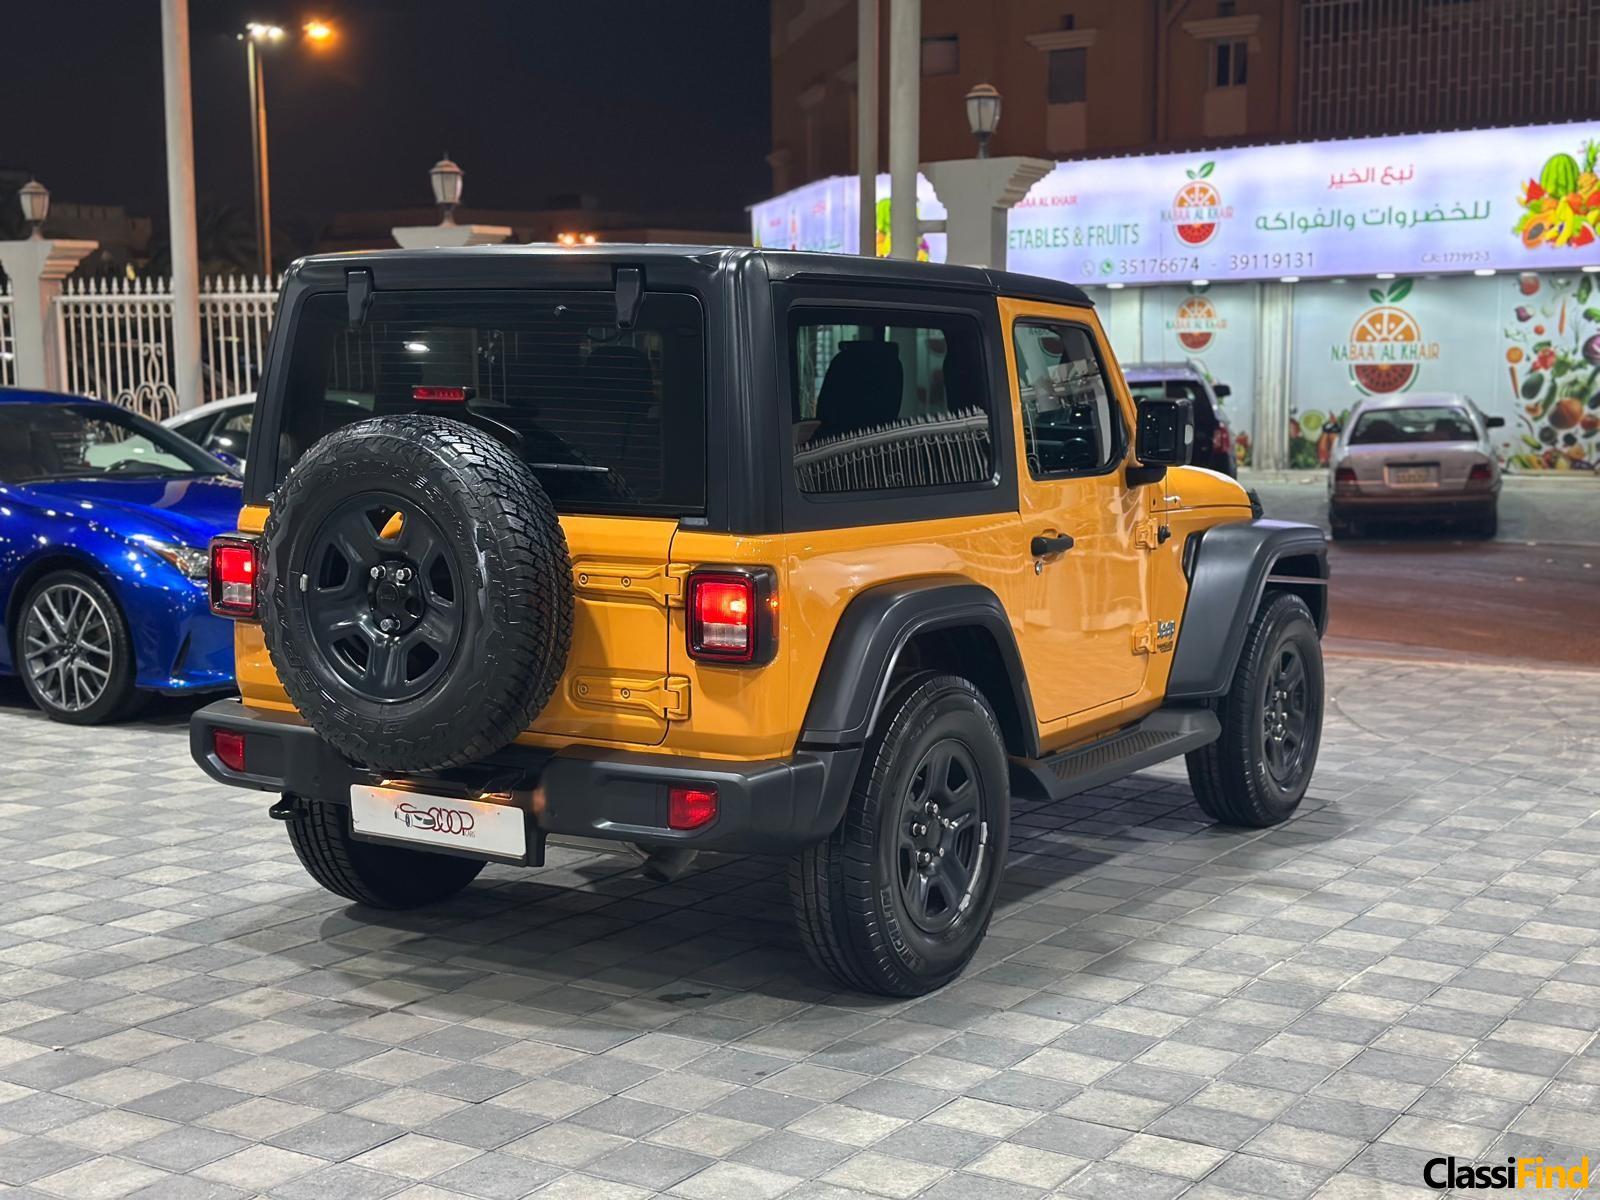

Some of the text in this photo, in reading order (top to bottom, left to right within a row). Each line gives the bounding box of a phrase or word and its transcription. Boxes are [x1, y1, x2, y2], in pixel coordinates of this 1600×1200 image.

[1327, 163, 1415, 191] نبع الخير
[1255, 200, 1491, 234] للخضروات والفواكه
[1008, 223, 1140, 249] ETABLES & FRUITS
[1119, 257, 1200, 275] 35176674
[1229, 252, 1314, 271] 39119131
[1331, 341, 1440, 361] NABAA AL KHAIR
